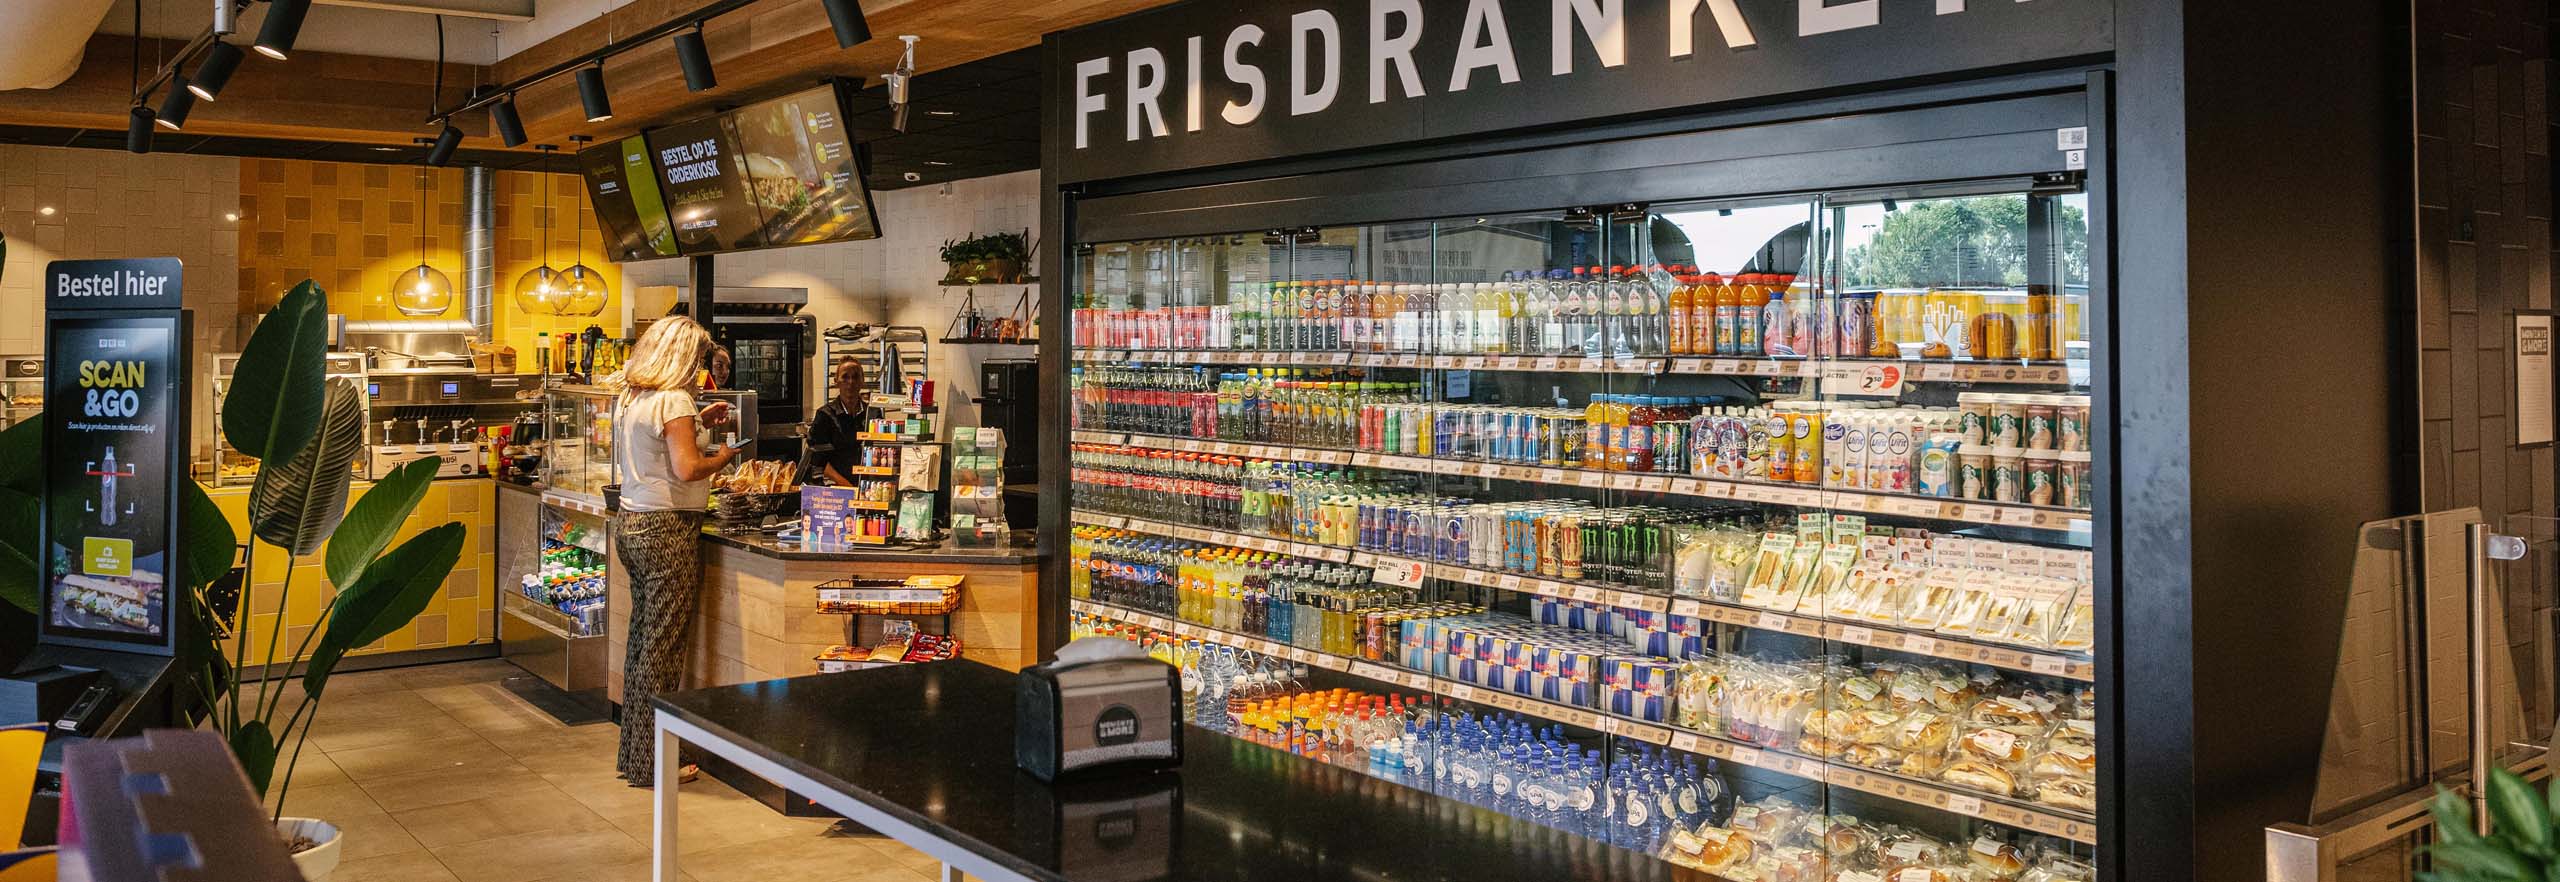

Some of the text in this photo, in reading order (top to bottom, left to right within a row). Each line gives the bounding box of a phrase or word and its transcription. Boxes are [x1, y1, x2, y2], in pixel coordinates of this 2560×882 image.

[661, 145, 693, 166] BESTEL
[691, 142, 704, 160] OP
[703, 139, 718, 157] DE
[2072, 152, 2079, 162] 3
[667, 159, 721, 185] ORDERKIOSK
[58, 270, 168, 297] Bestel hier
[79, 359, 145, 388] SCAN
[84, 388, 139, 418] &GO
